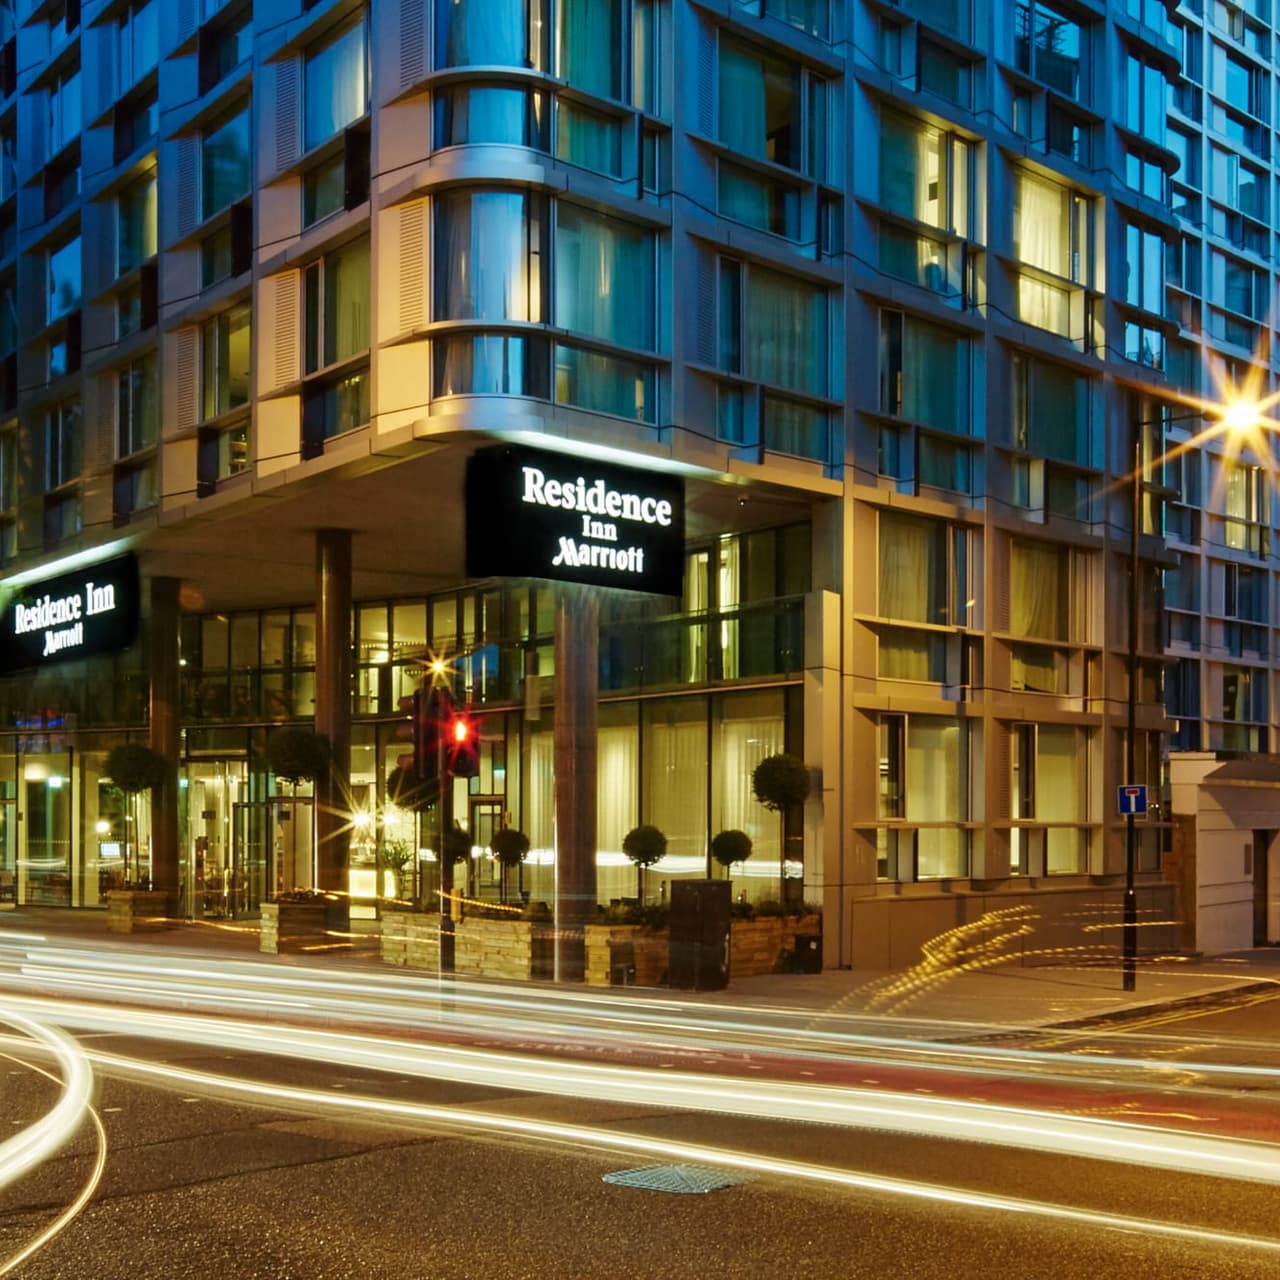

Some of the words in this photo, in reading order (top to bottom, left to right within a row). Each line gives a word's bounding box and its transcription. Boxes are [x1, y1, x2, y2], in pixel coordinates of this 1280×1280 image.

[521, 466, 671, 526] Residence
[581, 514, 617, 541] Inn
[551, 536, 644, 573] Marriott
[14, 594, 82, 634] Residence
[85, 581, 116, 616] Inn
[42, 621, 84, 657] Marriott
